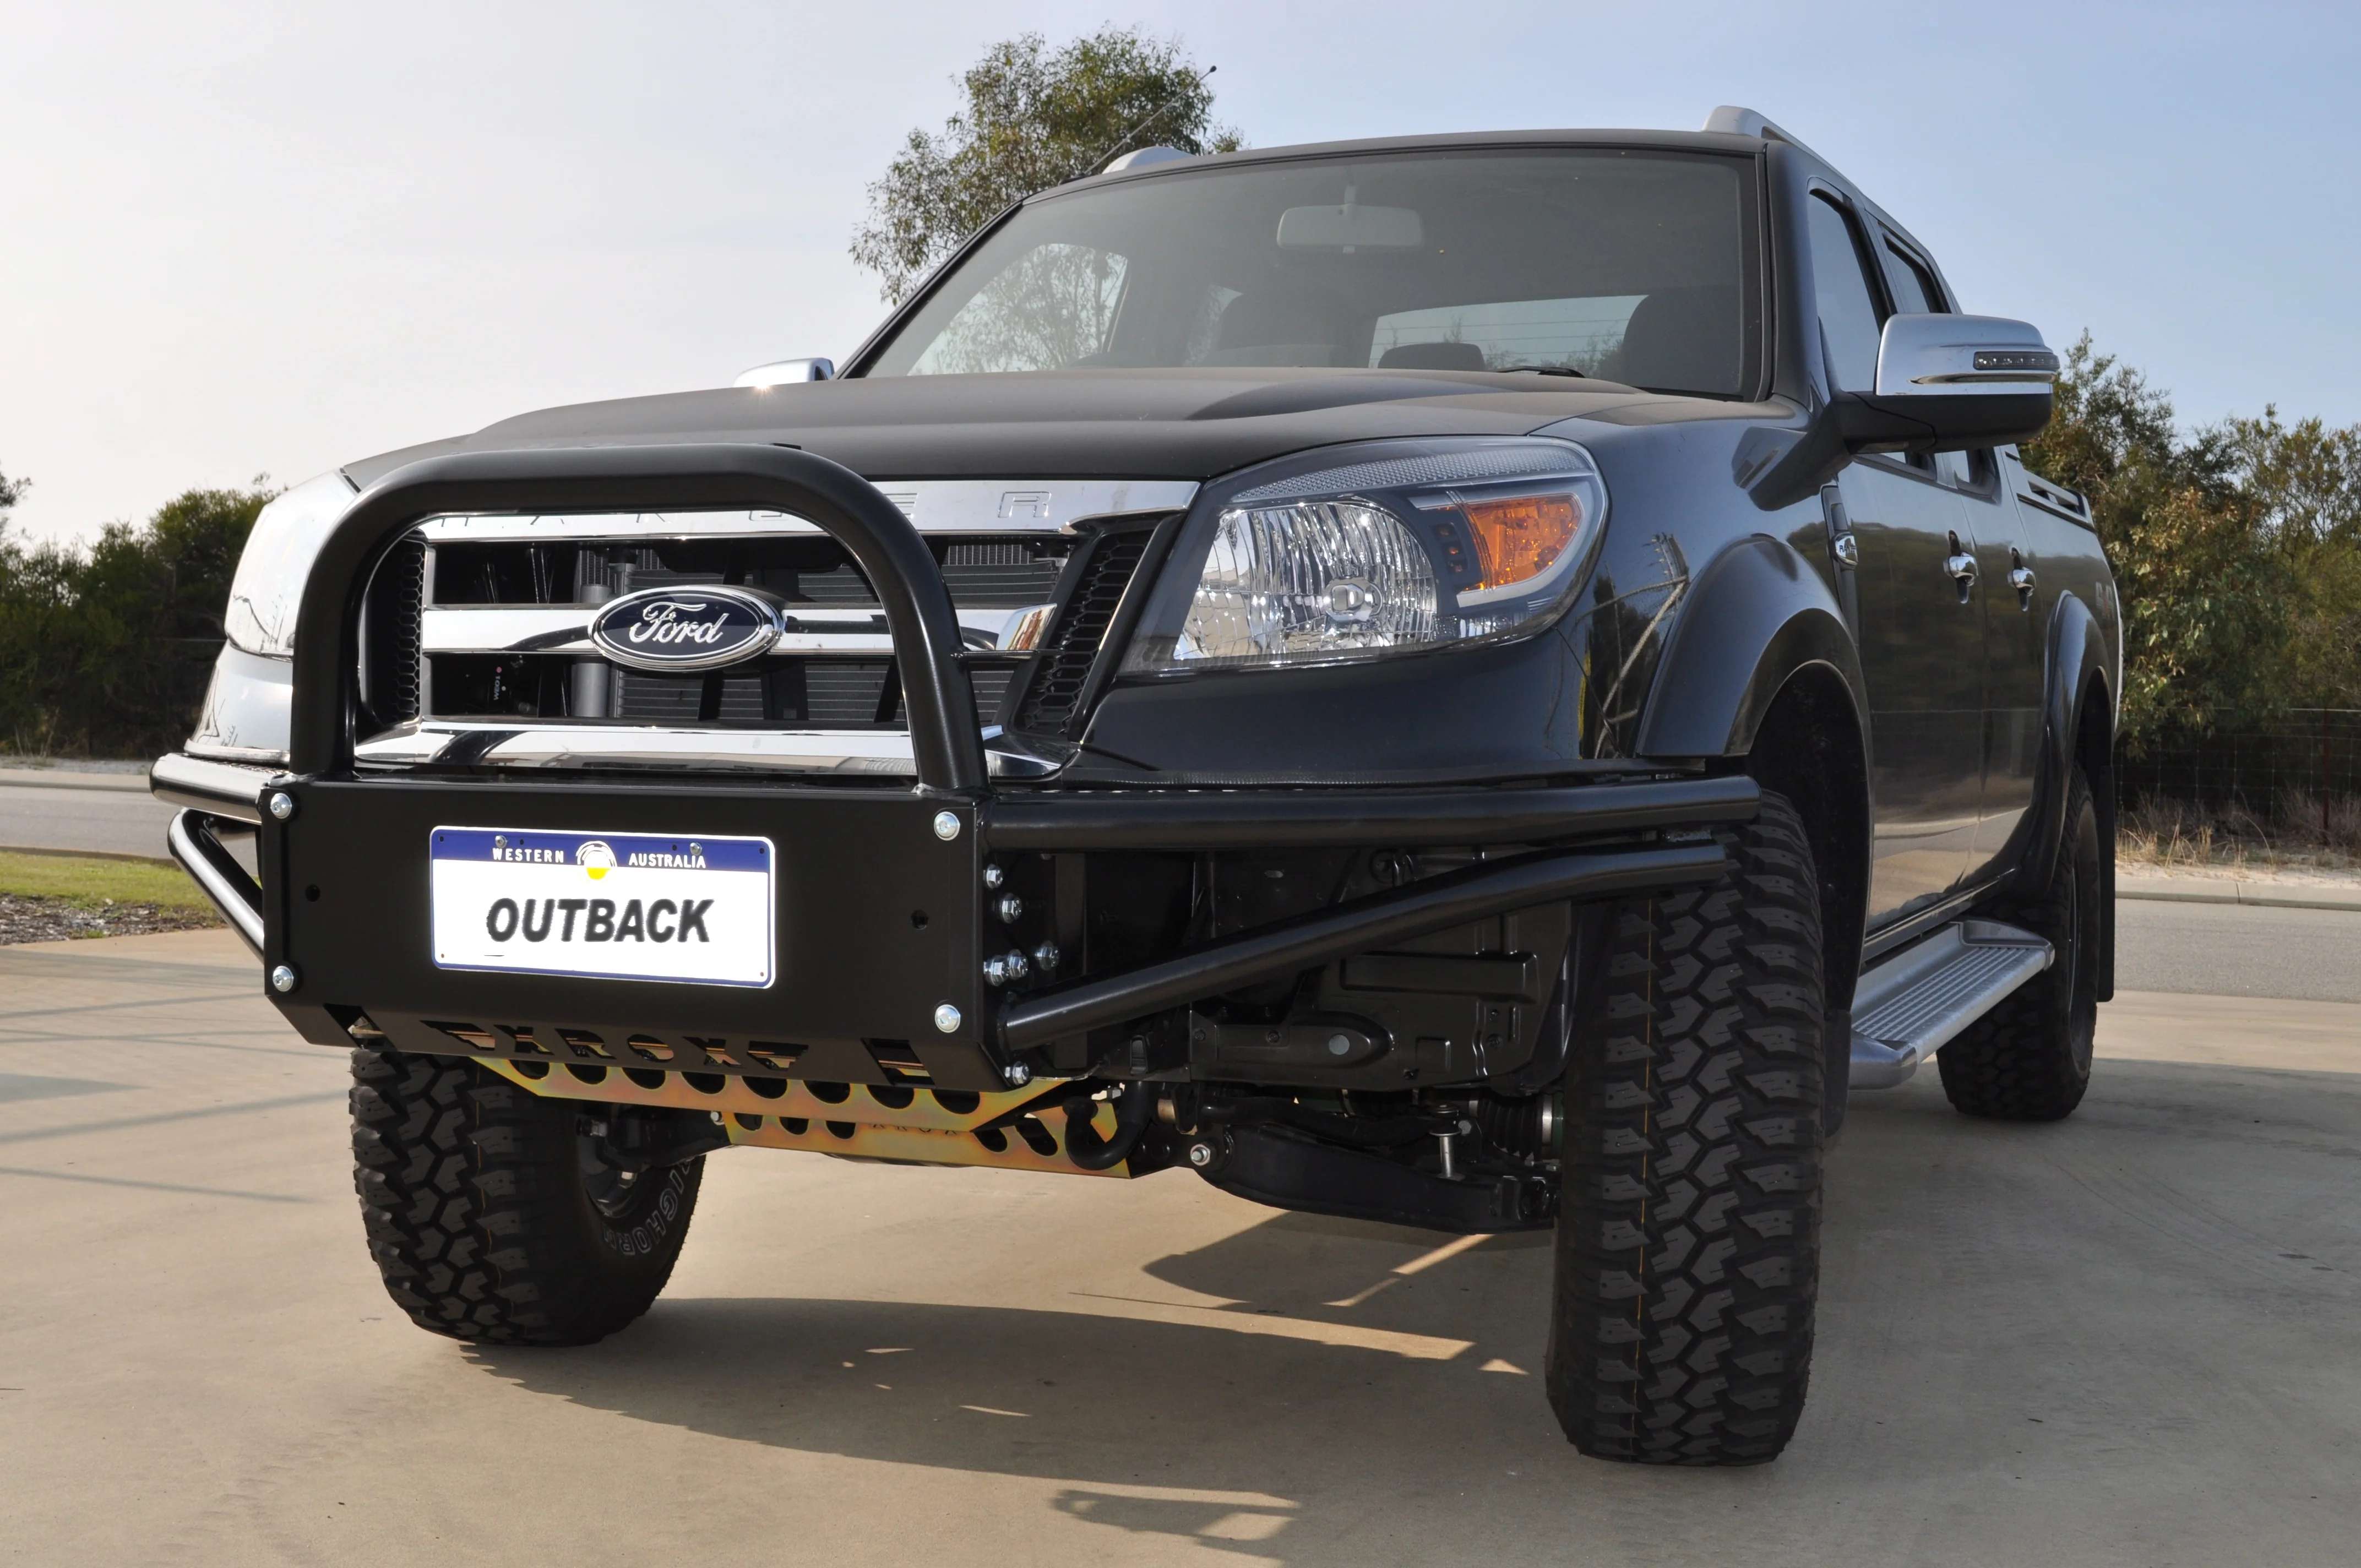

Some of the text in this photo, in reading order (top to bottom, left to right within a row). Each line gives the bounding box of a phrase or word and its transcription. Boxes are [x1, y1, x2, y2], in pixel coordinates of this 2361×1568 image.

[628, 601, 730, 644] Ford
[493, 847, 706, 869] WESTERN AUSTRALIA
[486, 897, 715, 943] OUTBACK
